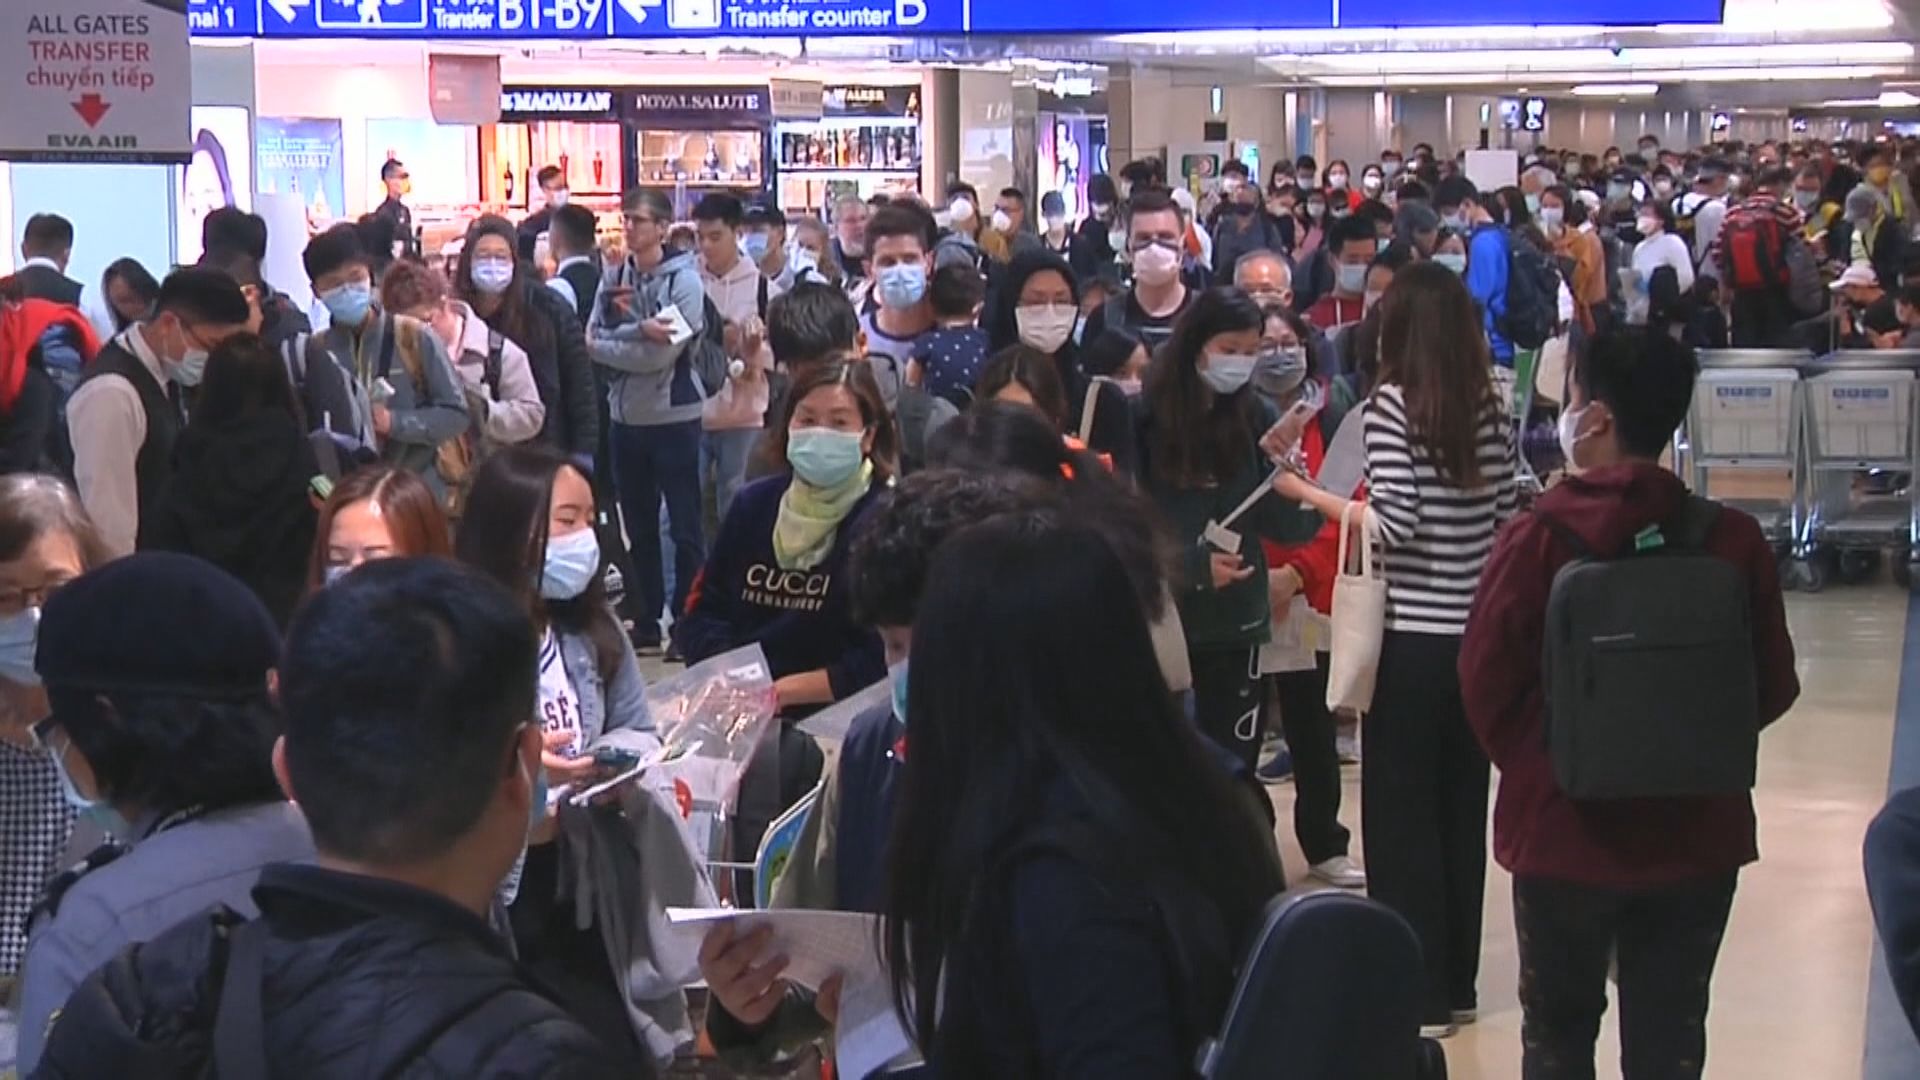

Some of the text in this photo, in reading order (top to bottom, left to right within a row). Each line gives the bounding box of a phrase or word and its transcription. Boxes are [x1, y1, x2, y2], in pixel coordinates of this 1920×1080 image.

[27, 15, 149, 35] ALL GATES
[189, 4, 234, 28] nal 1
[433, 0, 601, 30] Transfer B1-B9
[727, 0, 927, 28] Transfer counter B
[28, 41, 150, 62] TRANSFER
[47, 135, 137, 148] EVA AIR
